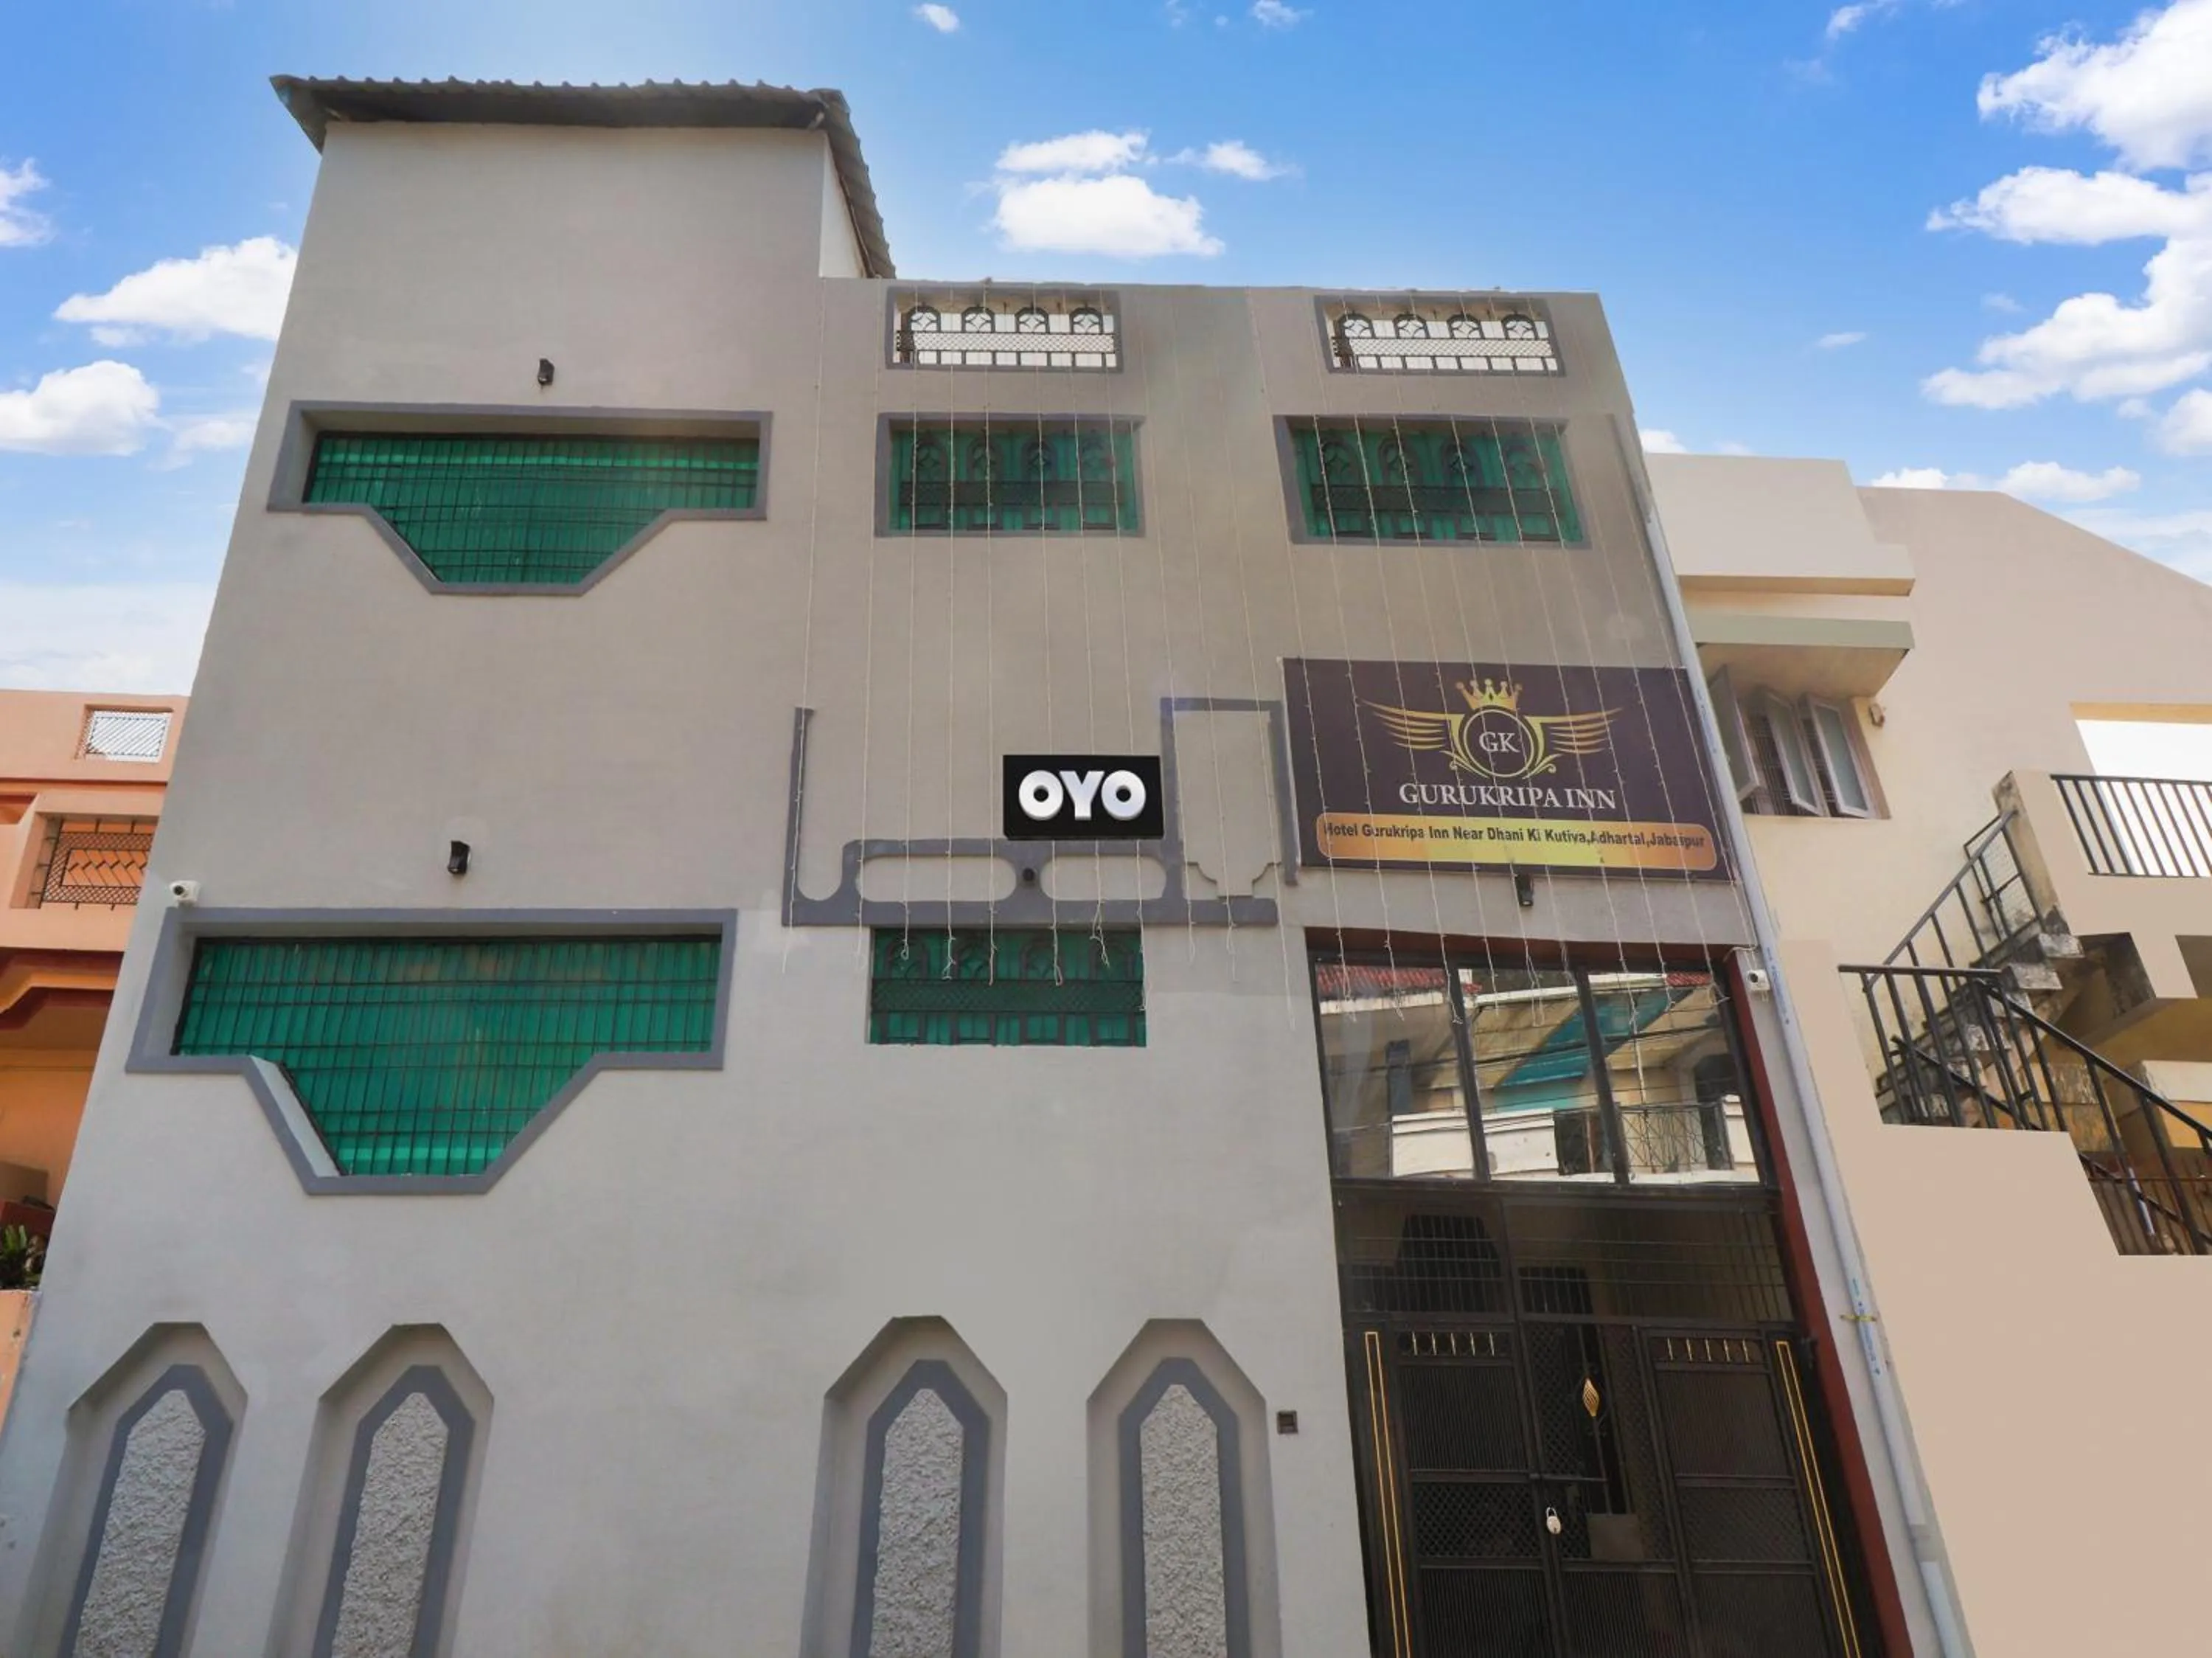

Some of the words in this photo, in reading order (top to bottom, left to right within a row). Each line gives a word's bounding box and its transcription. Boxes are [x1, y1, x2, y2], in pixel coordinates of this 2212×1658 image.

[1479, 731, 1520, 752] GK
[1018, 769, 1146, 820] OYO
[1399, 783, 1562, 808] GURUKRIPA
[1564, 788, 1616, 809] INN
[1324, 822, 1358, 836] Hotel
[1362, 823, 1425, 842] Gurukripa
[1428, 825, 1450, 839] Inn
[1453, 826, 1484, 840] Near
[1486, 827, 1524, 842] Dhani
[1526, 828, 1542, 842] Ki
